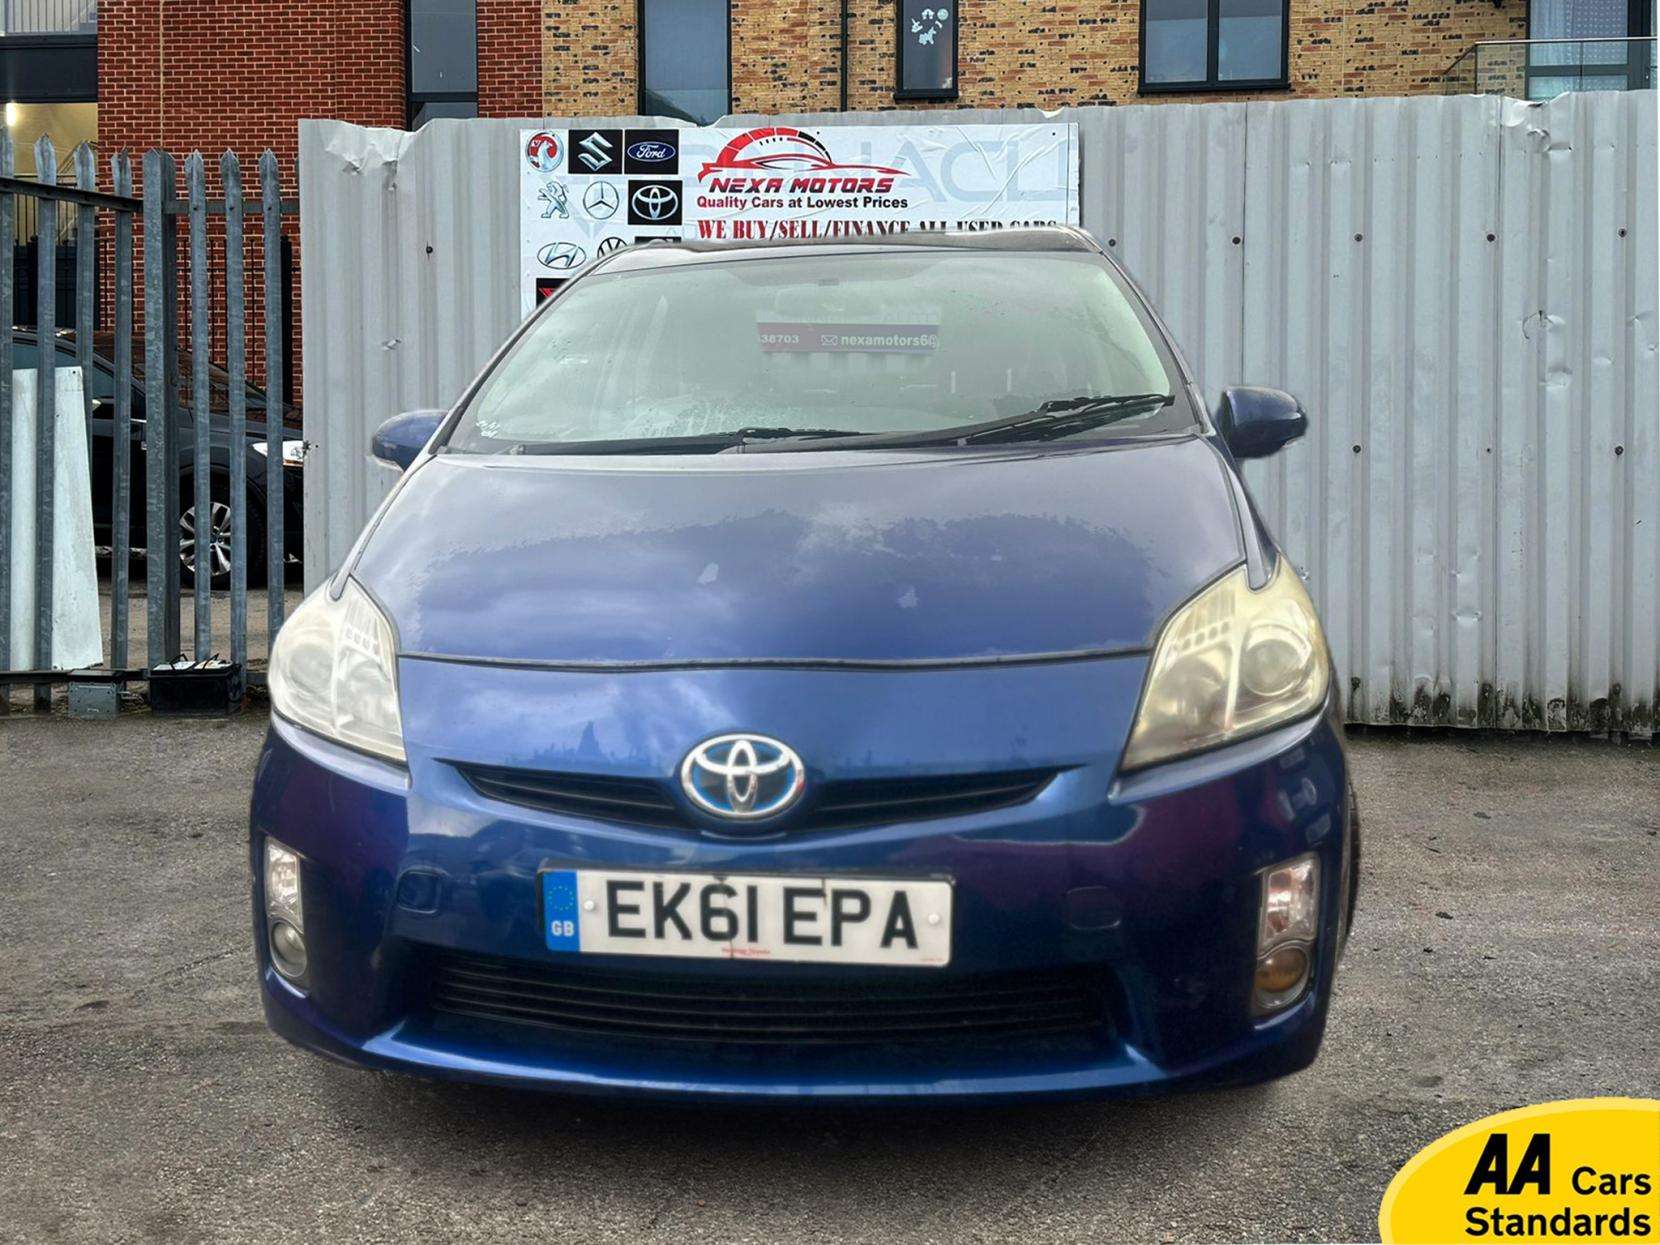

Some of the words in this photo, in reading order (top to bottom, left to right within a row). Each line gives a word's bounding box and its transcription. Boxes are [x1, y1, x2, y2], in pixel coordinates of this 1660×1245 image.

[636, 145, 666, 159] Ford
[709, 178, 781, 193] NEXA
[789, 178, 895, 193] MOTORS
[697, 196, 747, 210] Quality
[752, 196, 784, 208] Cars
[788, 197, 802, 208] at
[807, 196, 859, 208] Lowest
[863, 196, 908, 208] Prices
[697, 220, 726, 239] WE
[606, 880, 757, 944] EK61
[783, 886, 918, 950] EPA
[551, 920, 575, 937] GB
